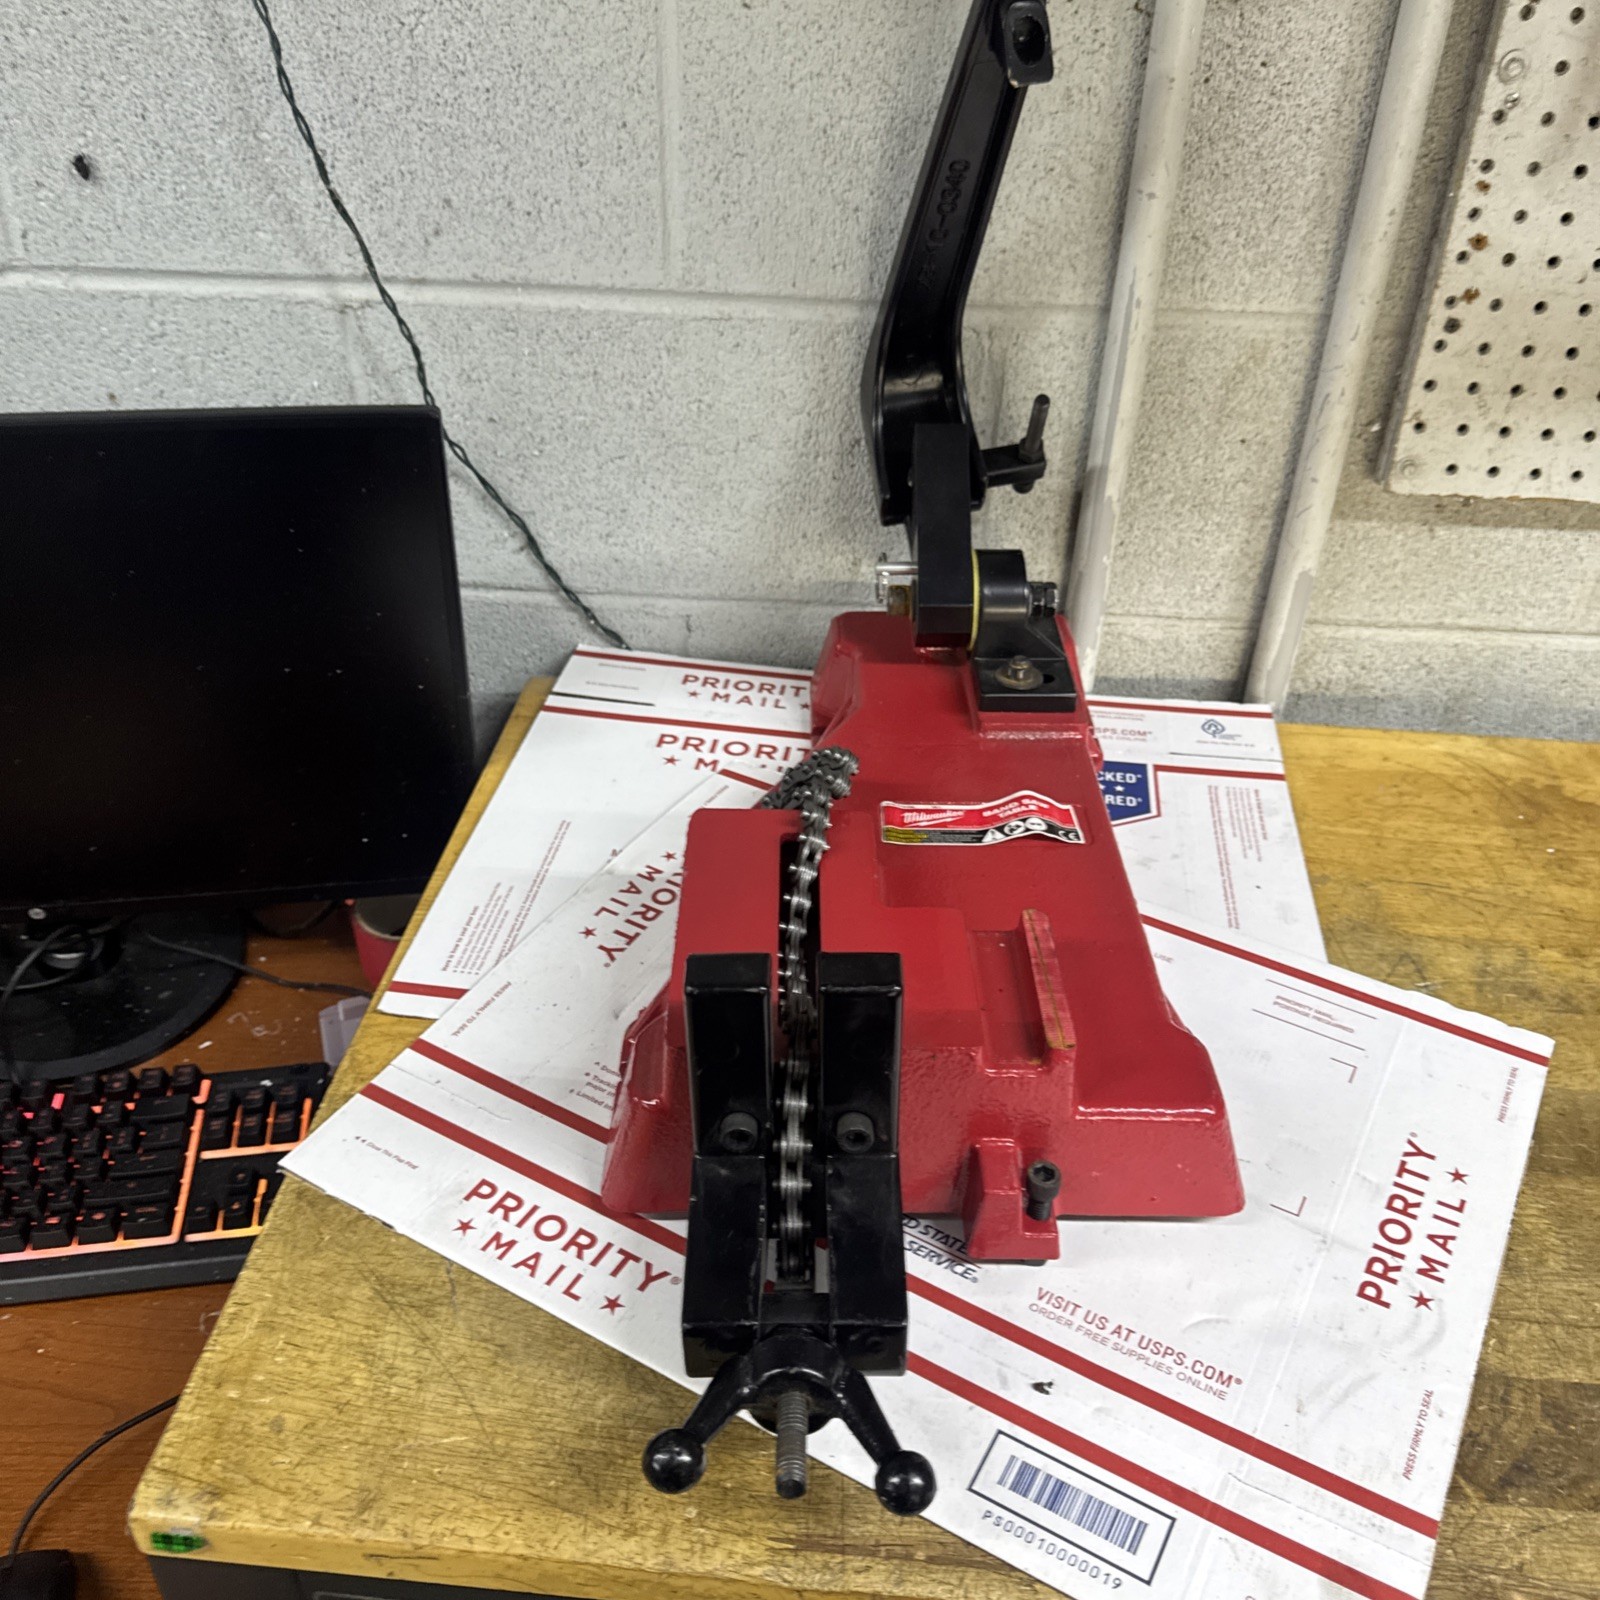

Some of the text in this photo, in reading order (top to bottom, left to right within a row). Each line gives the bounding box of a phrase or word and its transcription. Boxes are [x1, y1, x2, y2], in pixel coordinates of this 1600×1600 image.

[681, 674, 807, 698] PRIORIT
[711, 692, 787, 710] MAIL
[656, 733, 811, 763] PRIORIT
[593, 865, 664, 917] MAIL
[481, 1230, 582, 1301] MAIL
[918, 1224, 969, 1256] STATE
[1416, 1198, 1467, 1284] MAIL
[1037, 1286, 1083, 1316] VISIT
[1083, 1309, 1110, 1331] US
[1110, 1324, 1136, 1342] AT
[1028, 1303, 1228, 1401] ORDER FREE SUPPLIES ONLINE
[1402, 1389, 1435, 1481] PRESS FIRMLY TO SEAL
